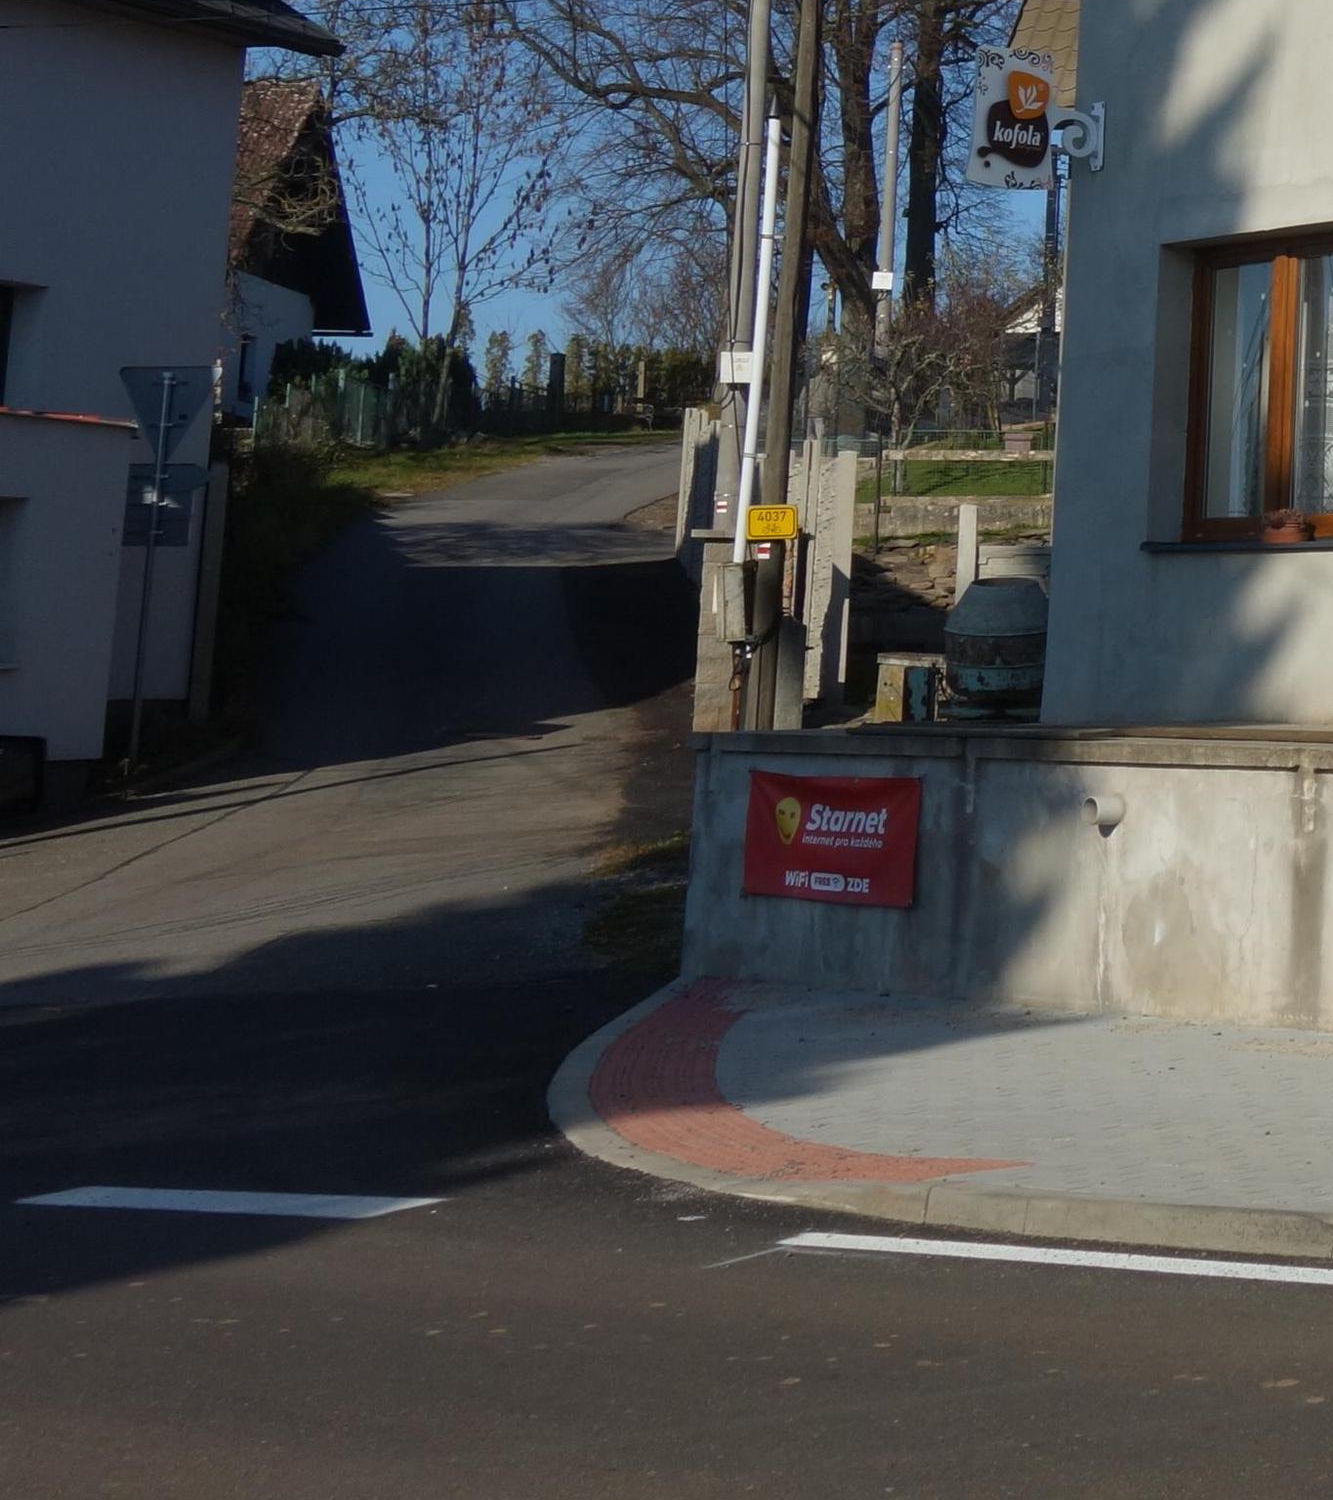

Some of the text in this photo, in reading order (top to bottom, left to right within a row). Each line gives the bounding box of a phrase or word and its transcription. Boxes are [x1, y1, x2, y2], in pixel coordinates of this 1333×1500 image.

[993, 120, 1041, 149] kofola
[756, 510, 786, 522] 4037
[805, 802, 888, 835] Starnet
[834, 837, 849, 849] pro
[785, 869, 870, 894] WiFi FREE ZDE
